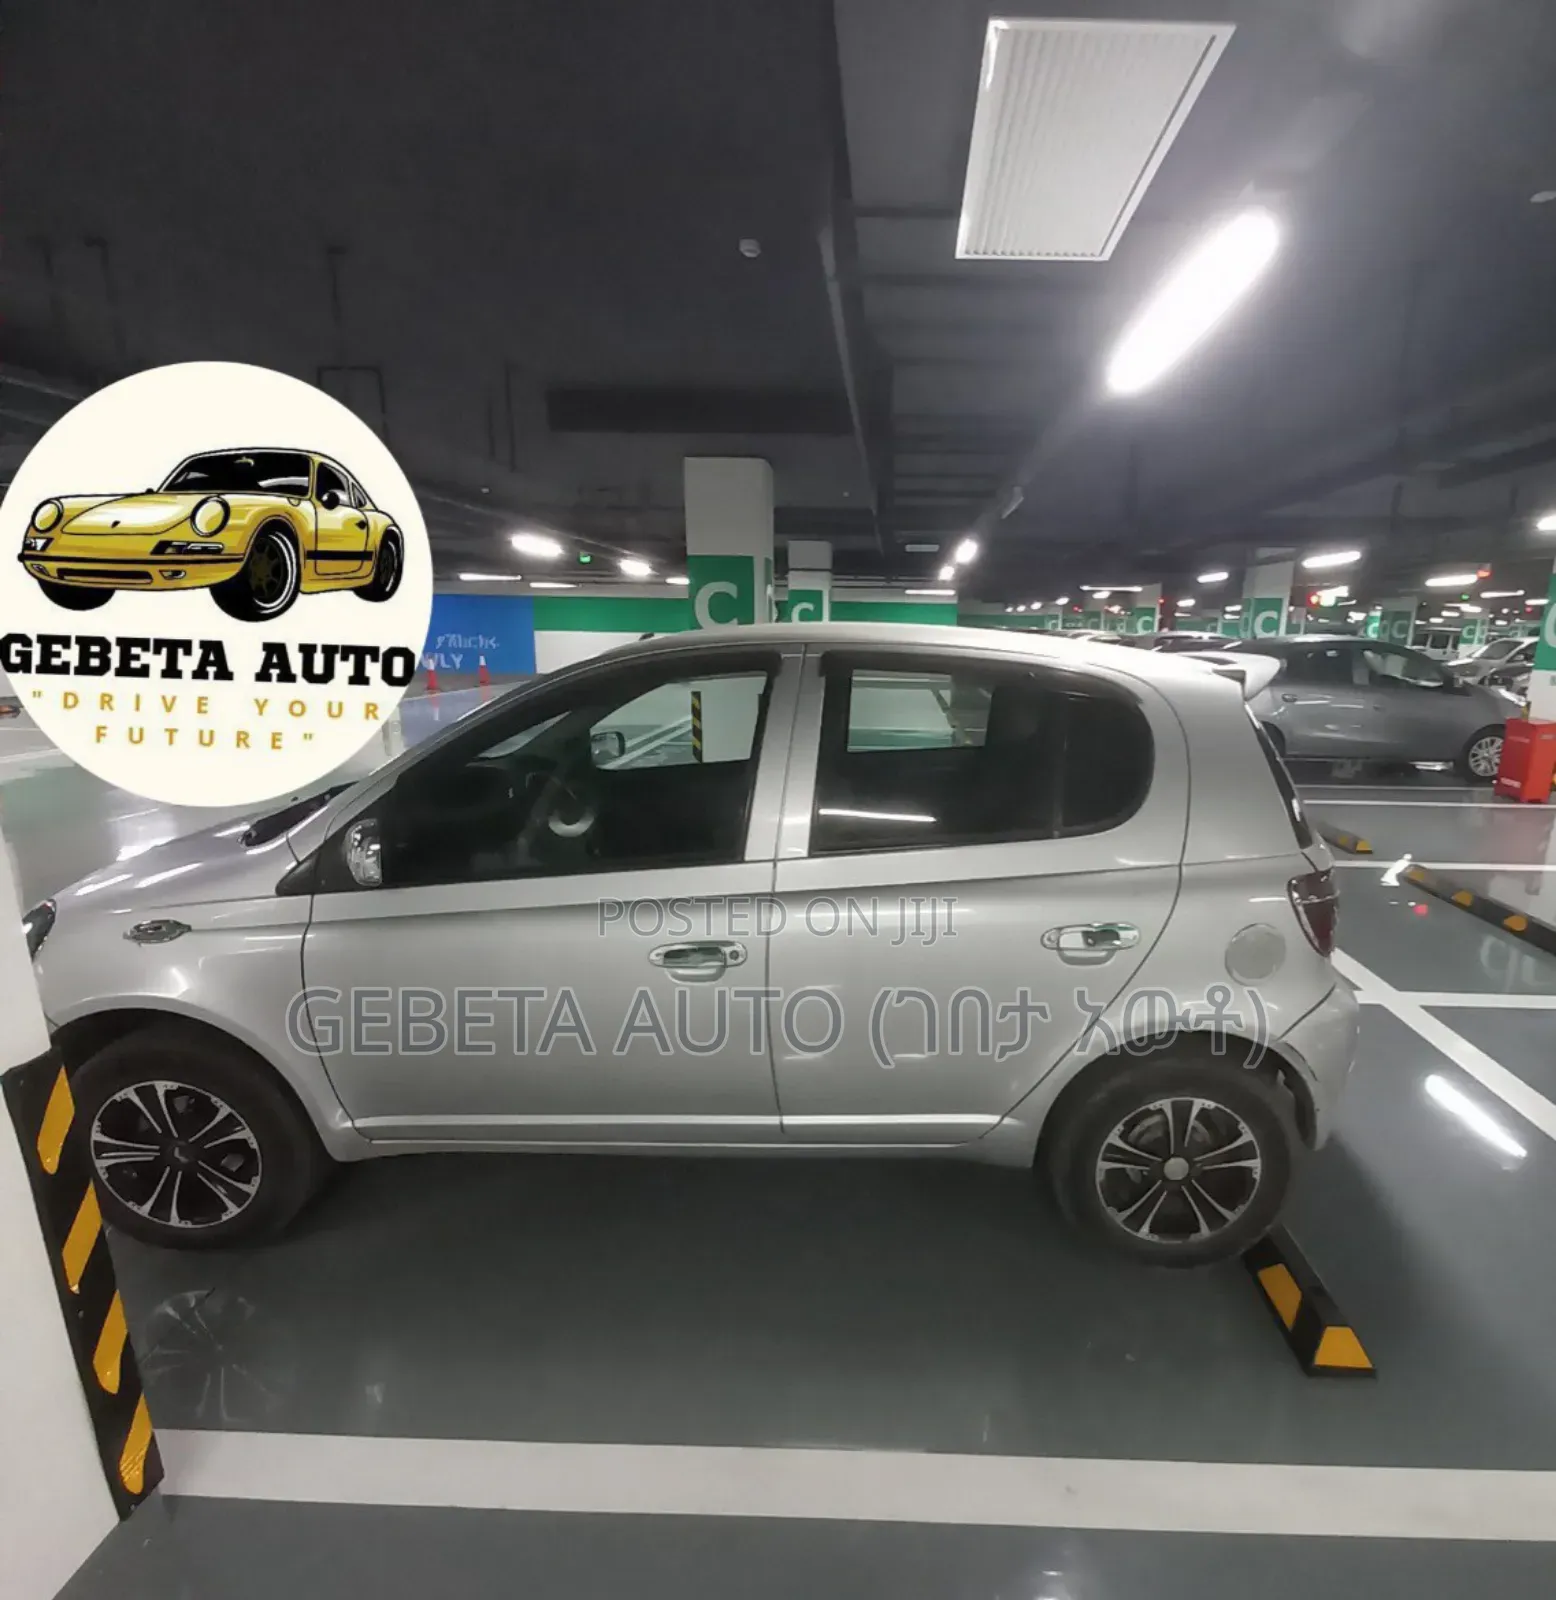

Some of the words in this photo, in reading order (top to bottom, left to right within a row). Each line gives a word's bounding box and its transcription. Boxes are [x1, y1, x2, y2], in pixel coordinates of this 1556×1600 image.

[694, 581, 738, 629] C
[1136, 616, 1153, 634] C
[1254, 610, 1279, 638] C
[1391, 620, 1409, 638] C
